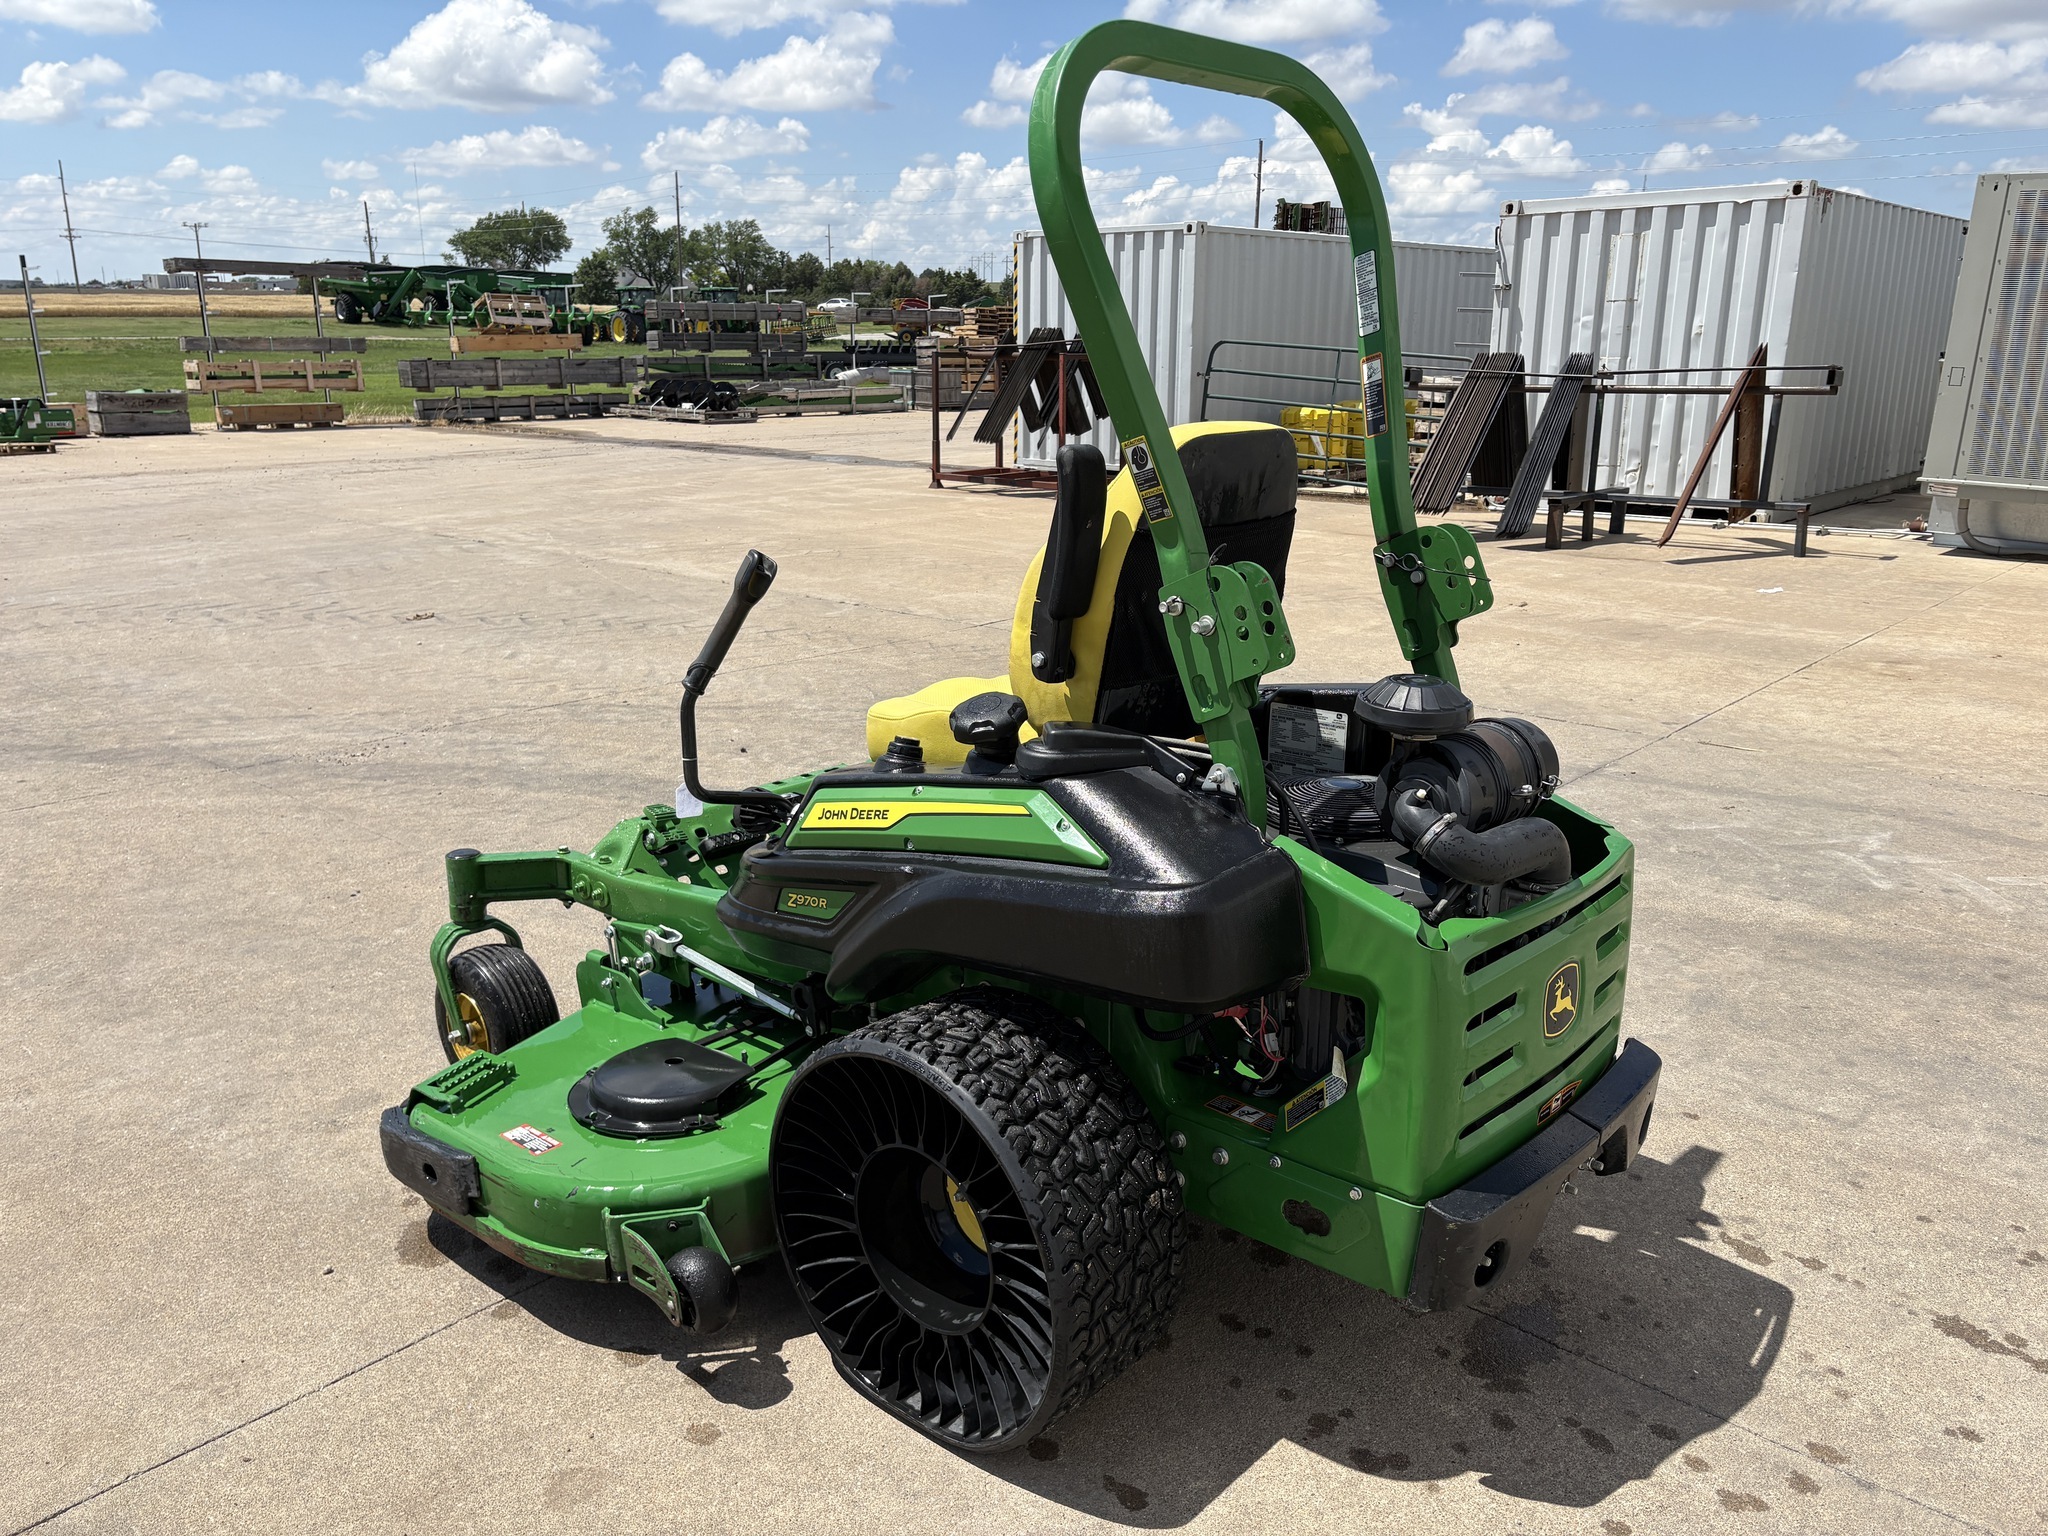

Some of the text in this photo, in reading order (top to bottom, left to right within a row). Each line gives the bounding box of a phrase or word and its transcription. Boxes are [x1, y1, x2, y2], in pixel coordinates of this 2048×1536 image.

[818, 807, 889, 820] JOHN DEERE
[787, 893, 827, 909] Z970R
[928, 1069, 953, 1091] TURF
